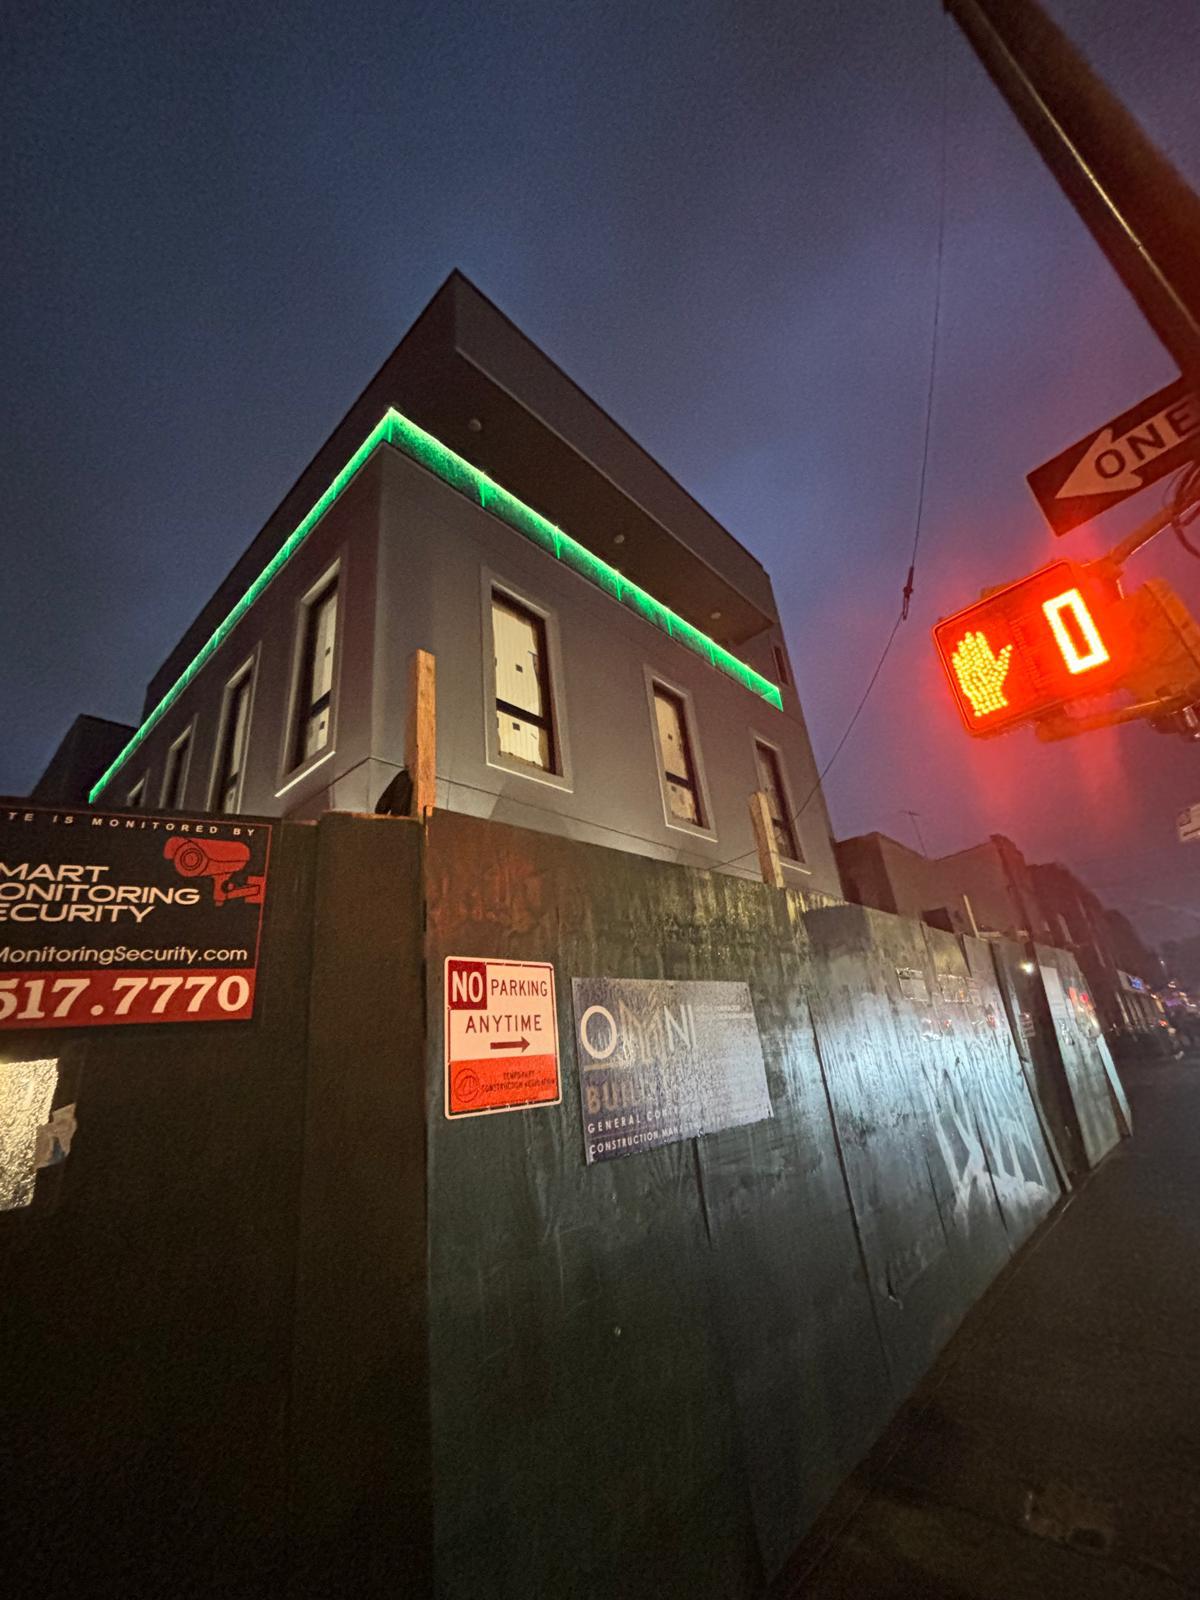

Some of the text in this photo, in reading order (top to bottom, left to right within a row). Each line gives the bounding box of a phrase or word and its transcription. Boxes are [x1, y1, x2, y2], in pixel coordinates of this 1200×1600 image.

[1094, 402, 1200, 479] ONE
[1042, 588, 1110, 674] 0
[52, 814, 74, 825] IS
[91, 817, 218, 834] MONITORED
[232, 827, 255, 836] BY
[0, 882, 200, 905] ONITORING
[451, 970, 548, 1003] NO PARKING
[465, 1014, 543, 1034] ANYTIME
[580, 999, 697, 1062] OMNI
[587, 1114, 641, 1134] GENERAL
[589, 1131, 659, 1155] CONSTRUCTION
